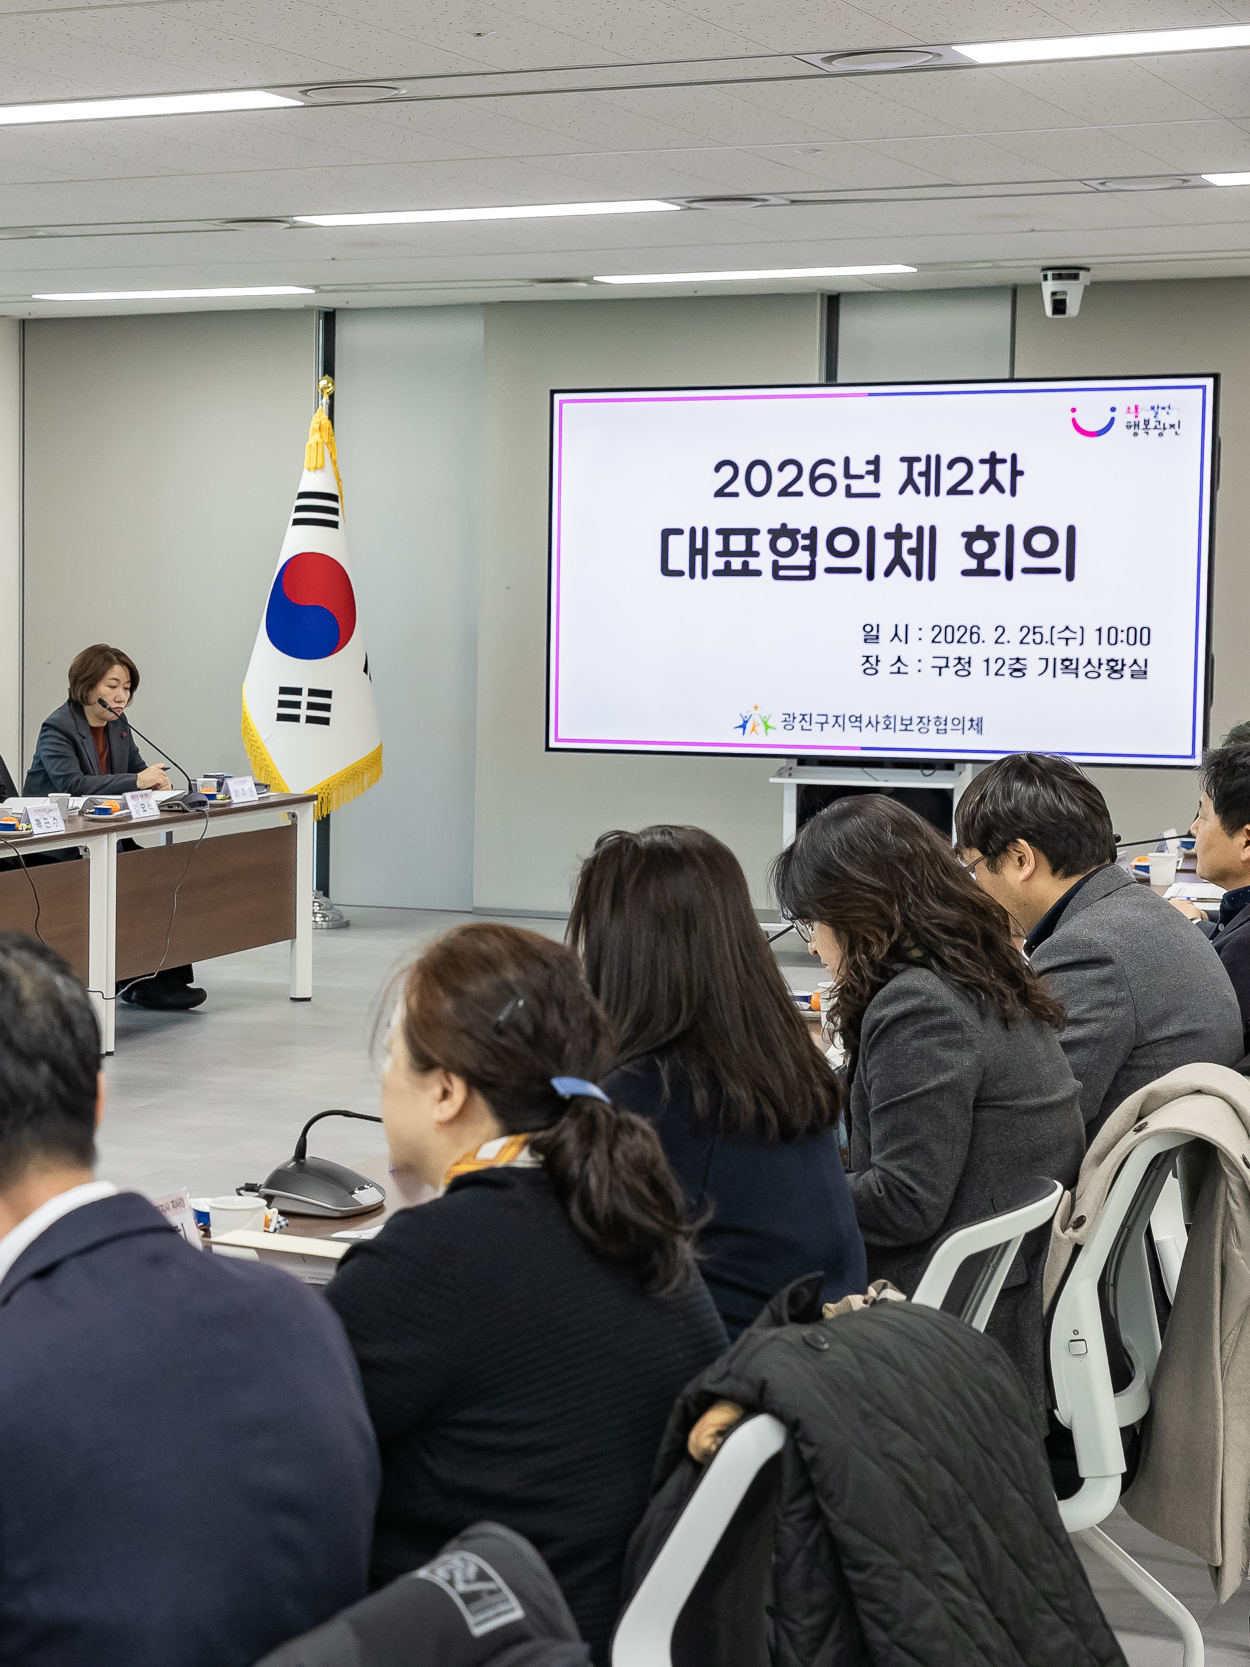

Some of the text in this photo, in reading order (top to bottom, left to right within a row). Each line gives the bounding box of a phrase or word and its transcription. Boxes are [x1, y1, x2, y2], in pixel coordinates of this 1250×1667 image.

[1125, 419, 1181, 438] 행복광진
[713, 451, 1025, 498] 2026년 제2차
[660, 522, 1077, 582] 대표협의체 회의
[1095, 626, 1151, 647] 10:00
[931, 655, 973, 678] 구청
[983, 656, 1028, 679] 12층
[1038, 656, 1149, 680] 기획상황실
[780, 711, 984, 735] 광진구지역사회보장협의체
